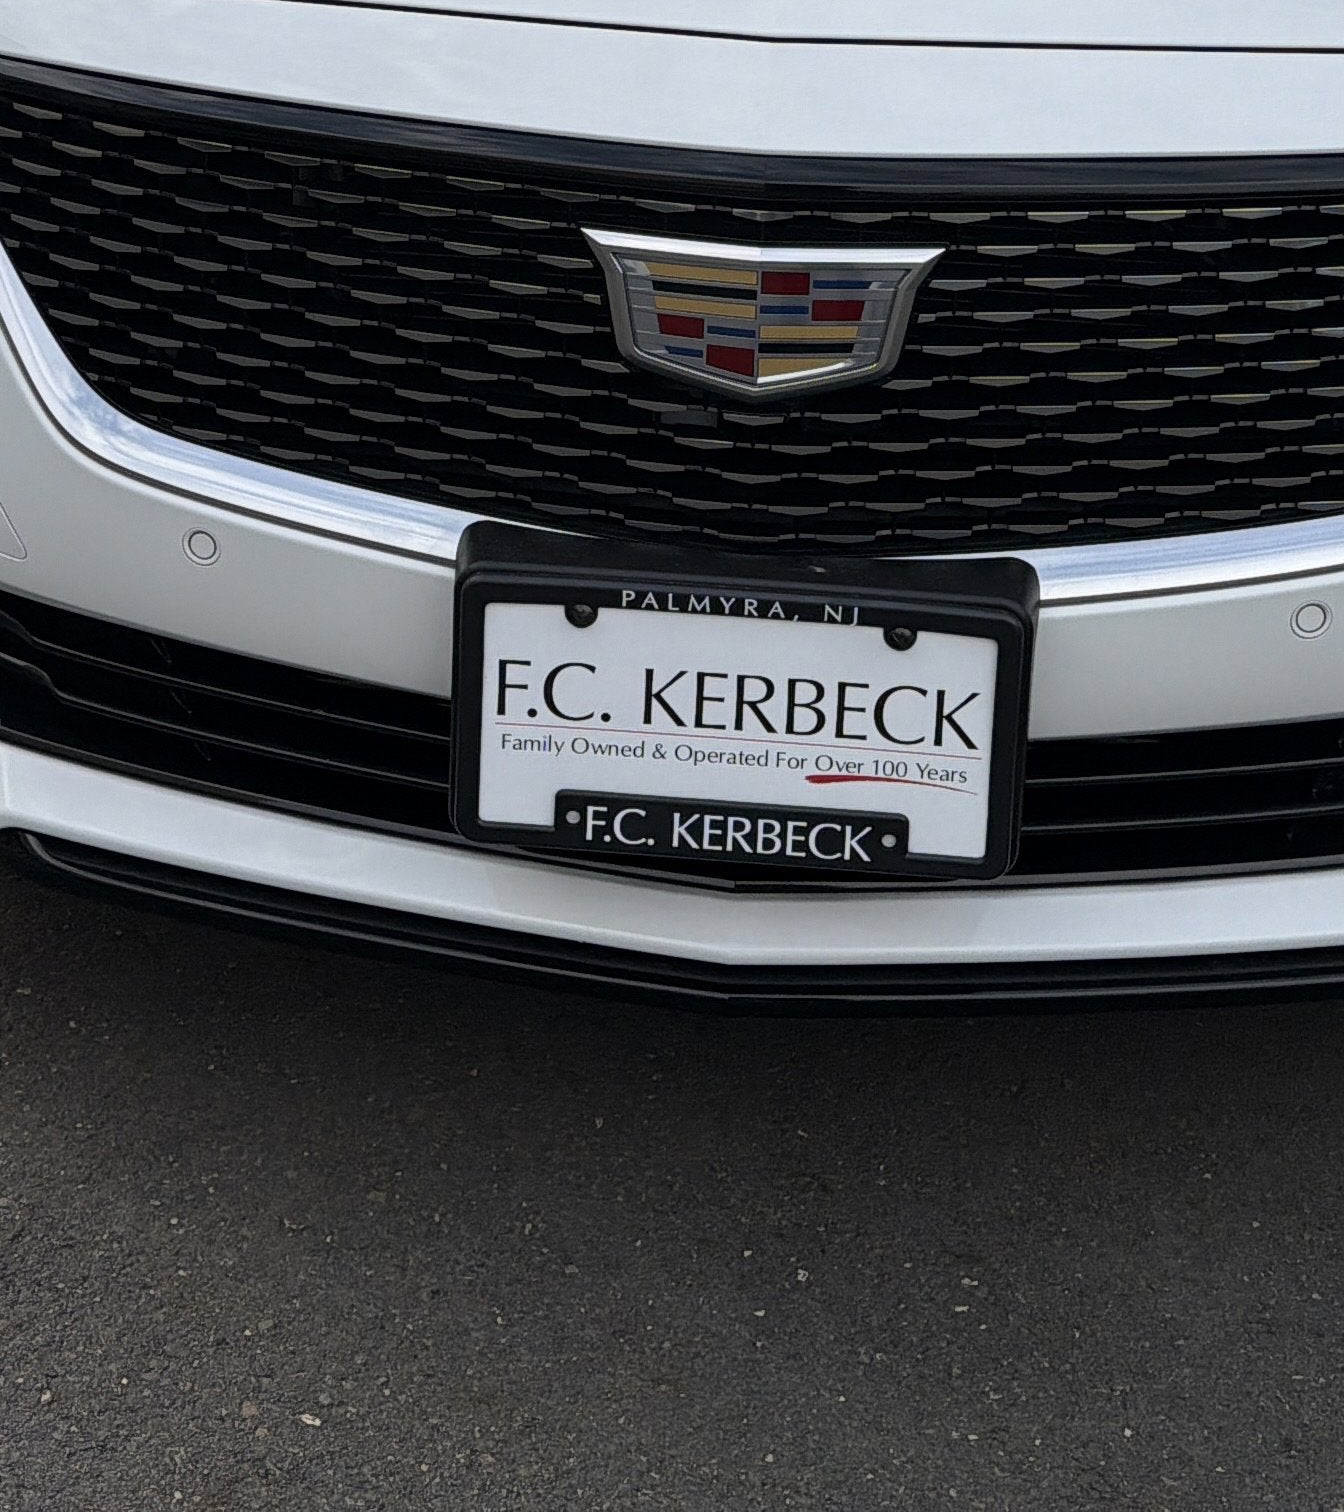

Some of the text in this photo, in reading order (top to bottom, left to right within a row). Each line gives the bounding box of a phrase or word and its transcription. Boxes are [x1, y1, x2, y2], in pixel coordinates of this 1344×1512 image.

[621, 590, 860, 627] PALMYRA, NJ
[496, 658, 982, 751] F.C. KERBECK
[501, 733, 968, 784] Family Owned & Operated For Over 100 Years
[585, 805, 872, 863] F.C. KERBECK
